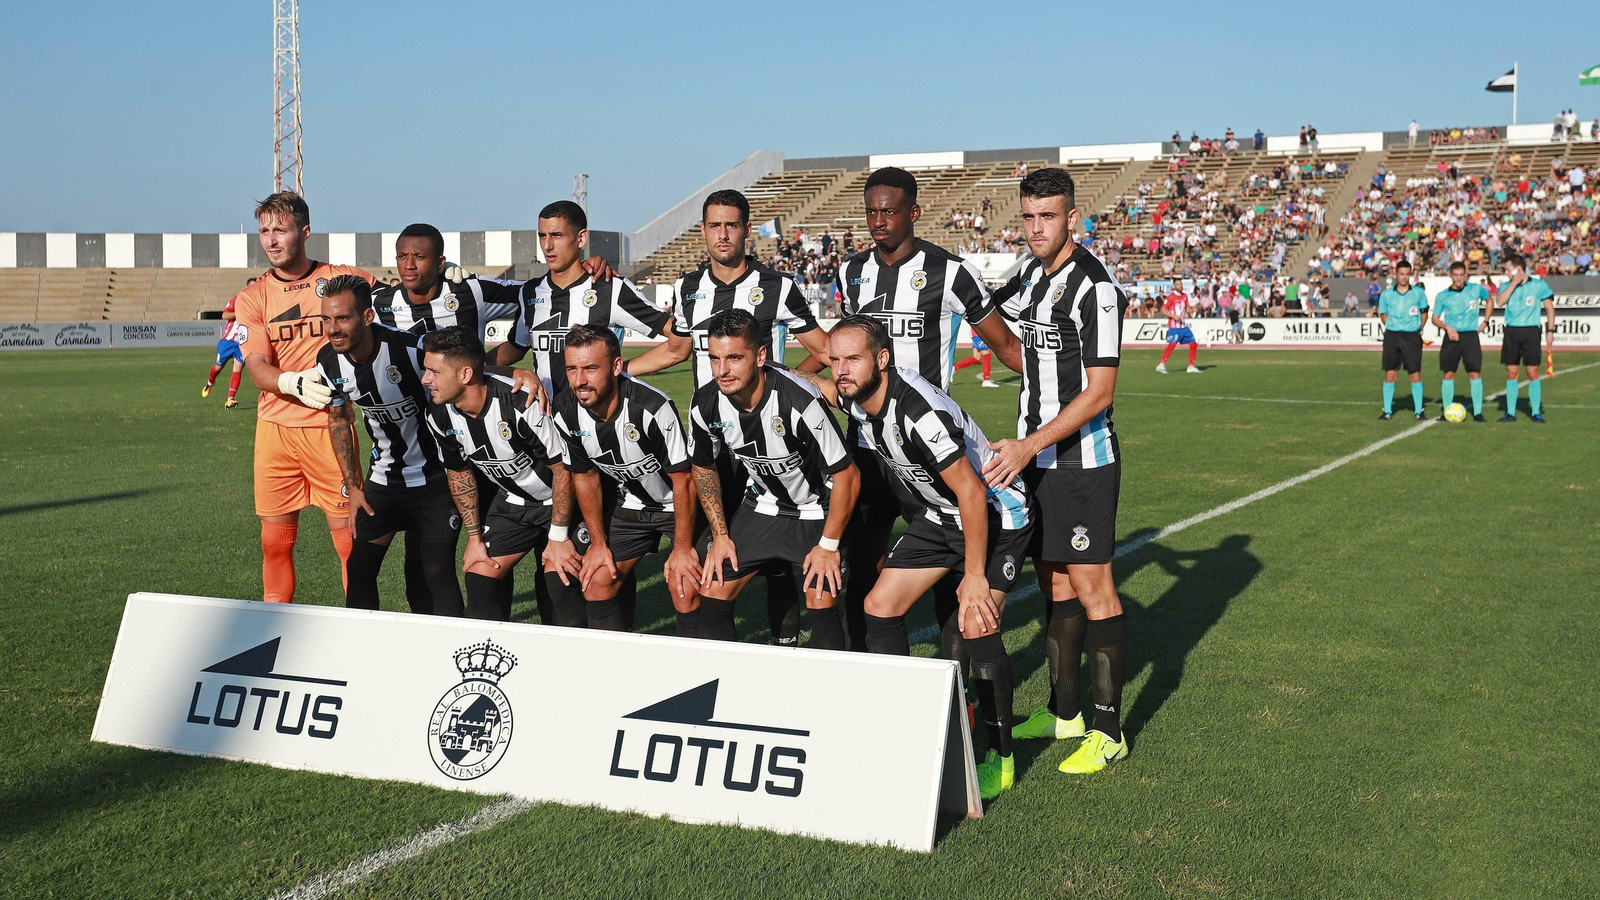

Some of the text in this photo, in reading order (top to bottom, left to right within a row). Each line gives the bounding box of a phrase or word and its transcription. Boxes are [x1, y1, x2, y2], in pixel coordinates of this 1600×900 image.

[283, 283, 311, 292] LEGEA
[123, 325, 157, 333] NISSAN
[268, 320, 324, 343] LOTU
[1019, 324, 1063, 350] TUS
[1283, 323, 1341, 334] MIREIA
[0, 334, 46, 347] armelina
[54, 332, 103, 347] Carmelina
[186, 681, 344, 740] LOTUS
[431, 683, 511, 778] REAL BALOMPEDICA LINENSE
[609, 729, 807, 798] LOTUS
